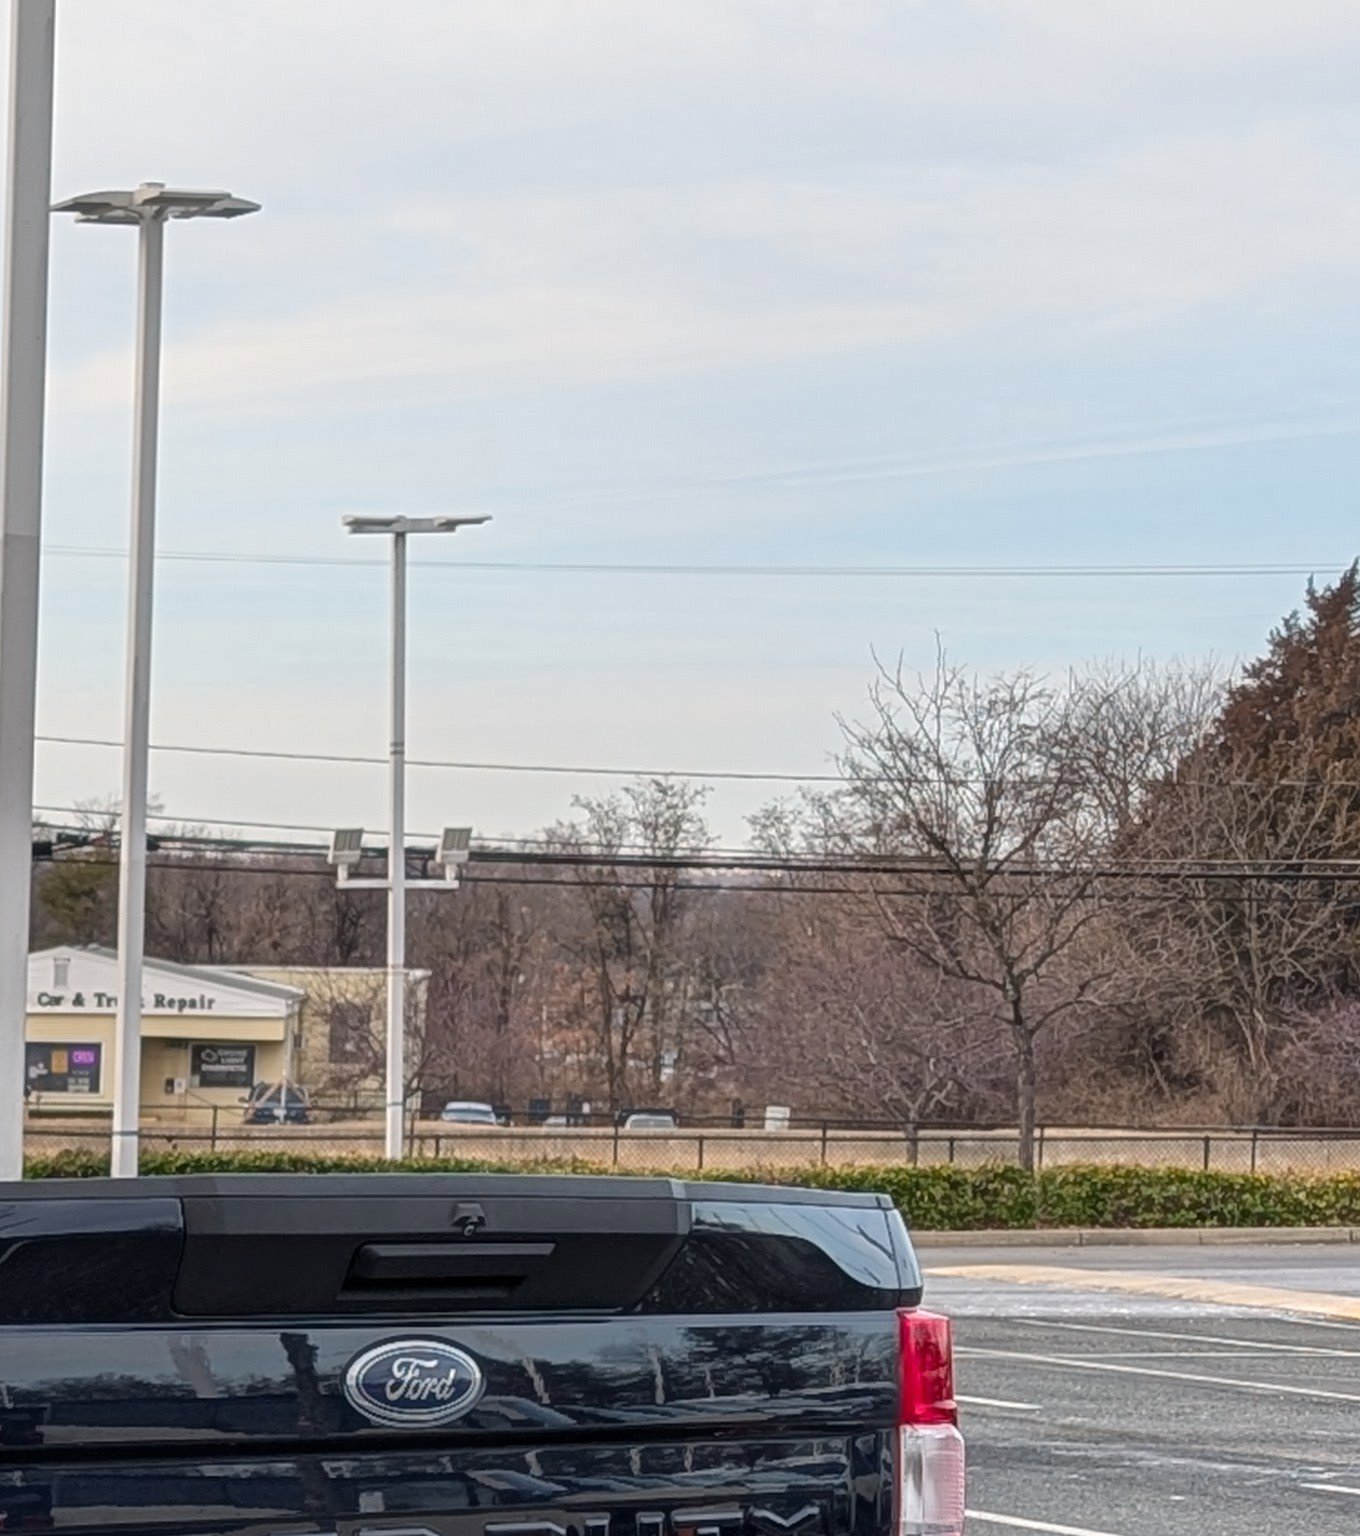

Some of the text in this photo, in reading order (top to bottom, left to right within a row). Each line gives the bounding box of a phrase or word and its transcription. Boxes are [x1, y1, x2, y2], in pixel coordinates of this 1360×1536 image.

[37, 992, 65, 1007] Car
[72, 991, 85, 1006] &
[153, 993, 216, 1013] Repair
[385, 1357, 457, 1401] Ford
